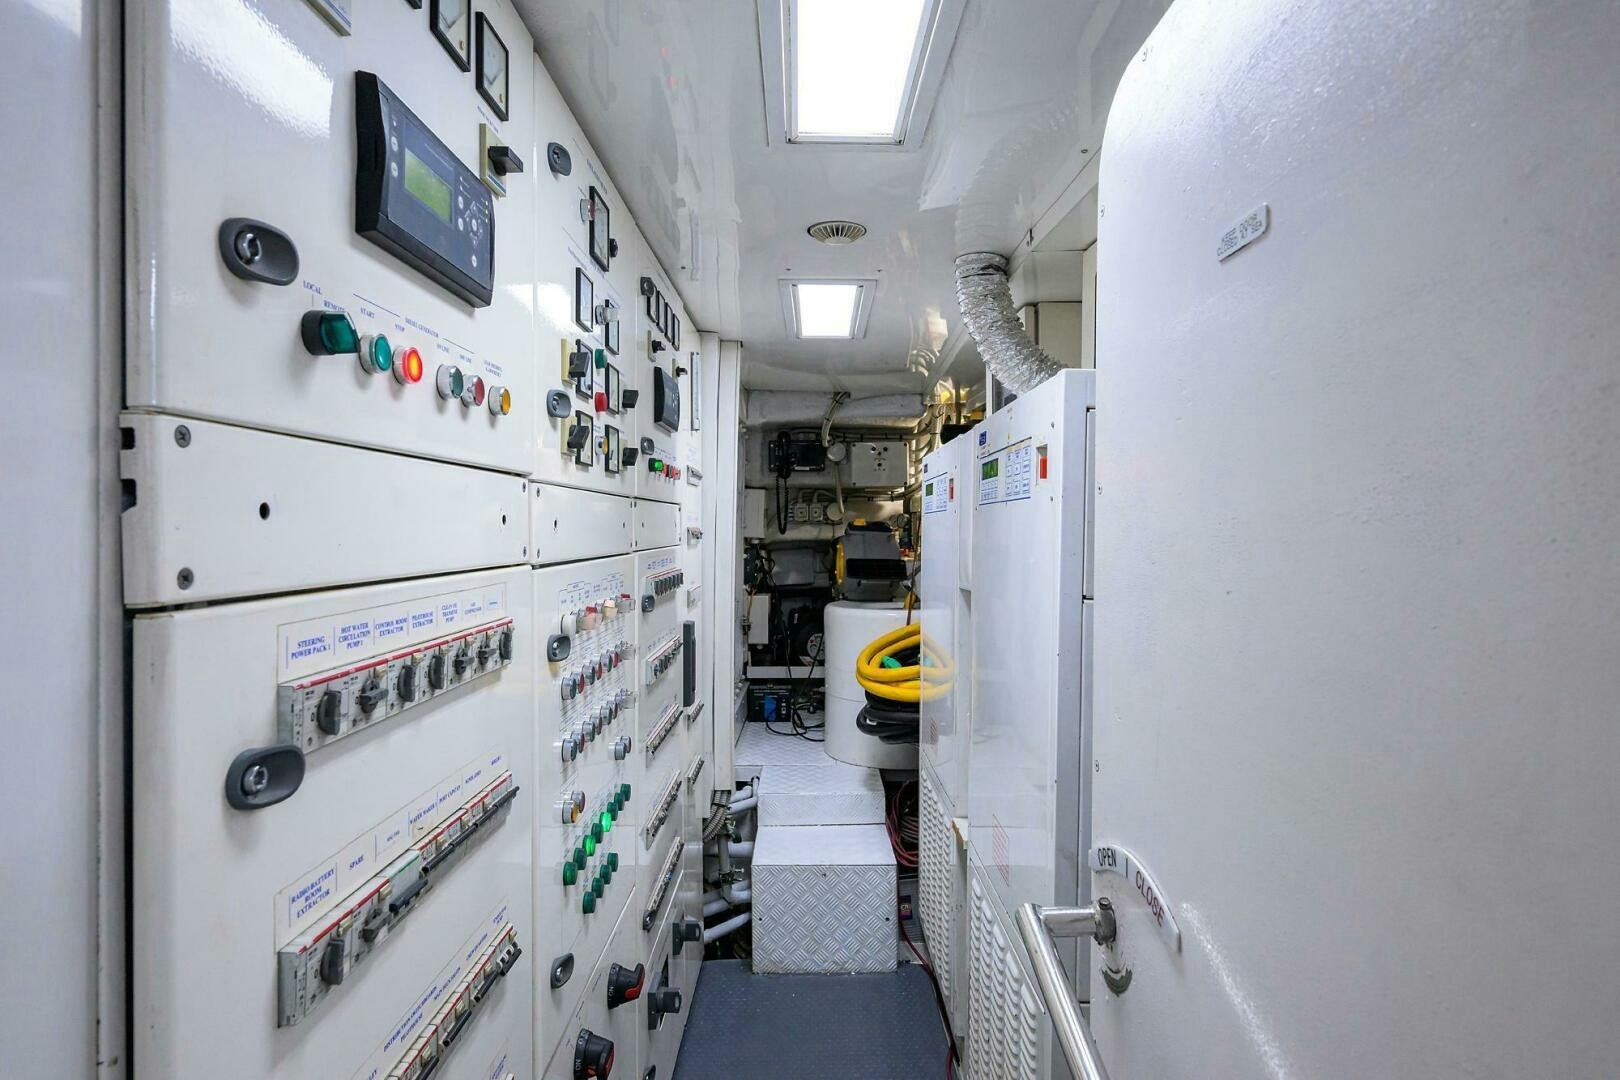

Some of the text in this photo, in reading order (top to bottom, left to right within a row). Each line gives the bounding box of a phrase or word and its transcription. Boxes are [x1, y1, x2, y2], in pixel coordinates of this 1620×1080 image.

[304, 280, 322, 295] LOCAL
[324, 300, 345, 312] REMOT
[360, 308, 375, 319] START
[340, 622, 369, 634] HOT WATER
[375, 616, 408, 630] CONTROL ROOM
[412, 619, 434, 629] EXTRACTOR
[338, 630, 371, 643] CIRCULATION
[379, 626, 404, 637] EXTRACTOR
[297, 636, 325, 649] STEERING
[346, 641, 360, 650] PUMP
[291, 648, 312, 660] POWER
[312, 644, 327, 655] PACK
[349, 854, 364, 870] SPARE
[1097, 848, 1117, 868] OPEN
[304, 886, 322, 904] ROOM
[1135, 870, 1165, 927] CLOSE
[296, 888, 331, 919] EXTRACTOR
